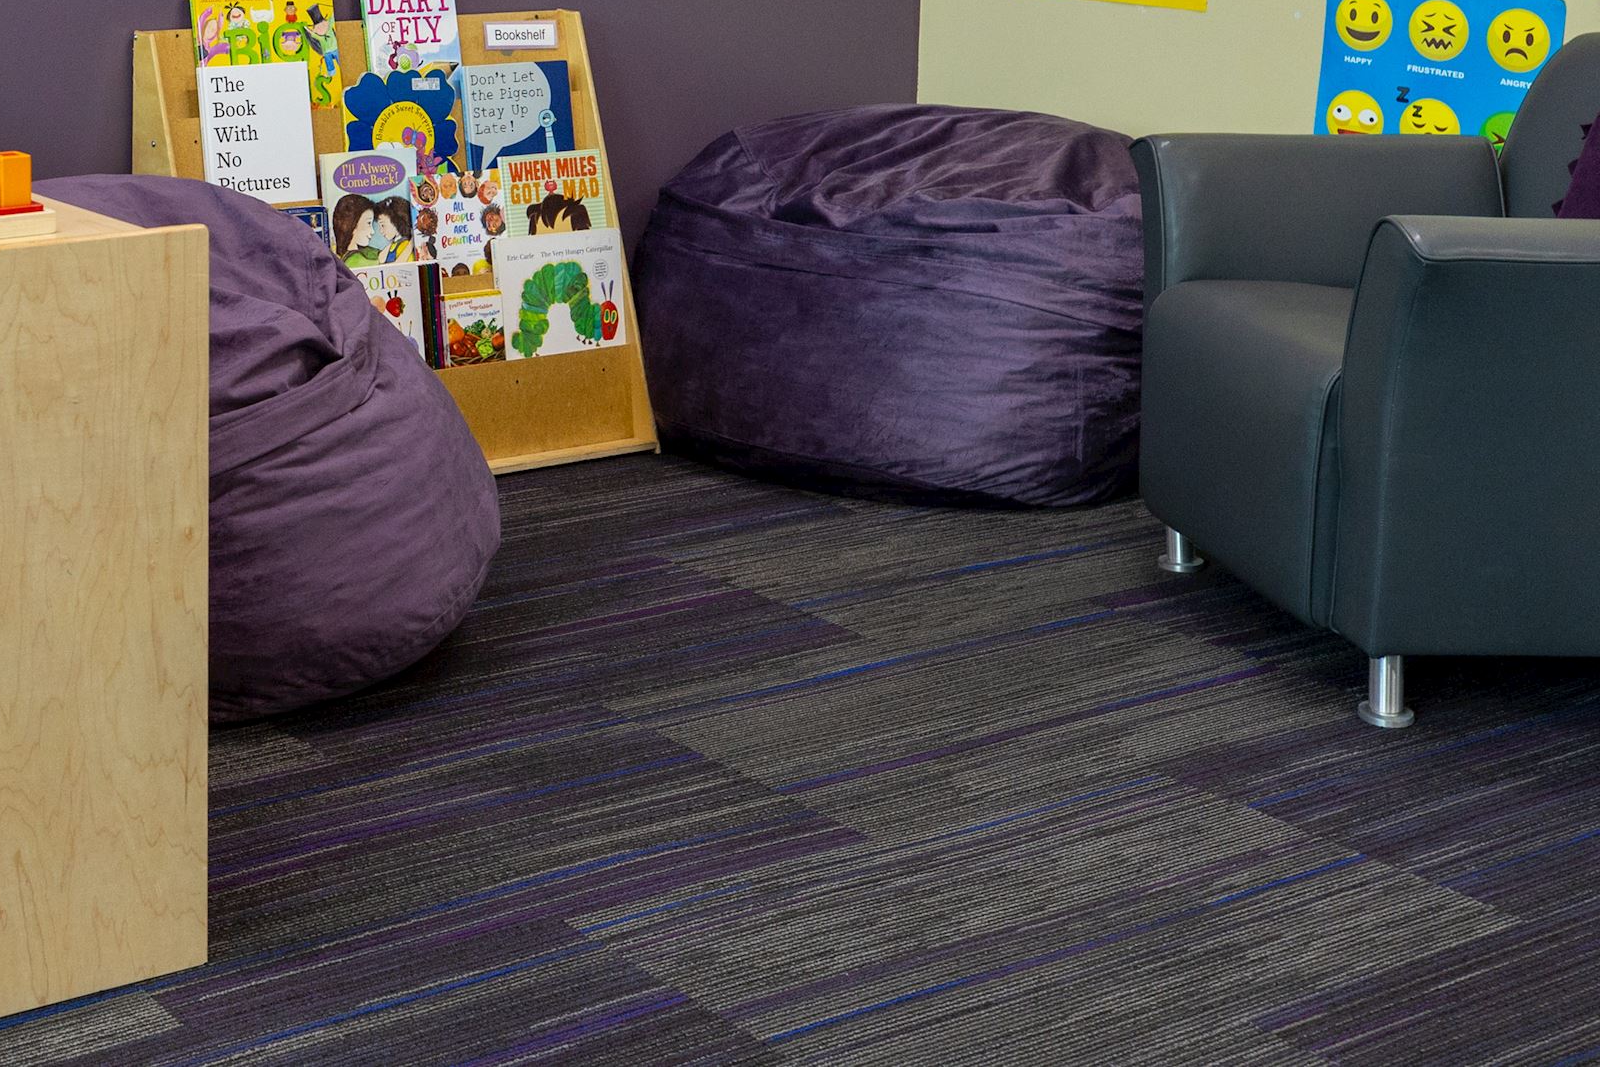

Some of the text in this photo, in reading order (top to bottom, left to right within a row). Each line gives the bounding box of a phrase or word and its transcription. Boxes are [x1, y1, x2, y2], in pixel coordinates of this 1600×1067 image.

[381, 21, 396, 34] OF
[396, 15, 442, 44] FLY
[495, 29, 546, 42] Bookshelf
[1344, 55, 1373, 66] HAPPY
[470, 70, 534, 86] Don't Let
[1406, 64, 1465, 79] FRUSTRATED
[211, 76, 245, 93] The
[1500, 78, 1531, 89] ANGRY
[471, 87, 544, 103] the Pigeon
[212, 100, 257, 118] Book
[473, 104, 528, 120] Stay Up
[415, 107, 434, 138] Surprise
[475, 120, 515, 135] Late!
[214, 125, 259, 143] With
[216, 152, 242, 168] No
[341, 162, 397, 176] I'll Always
[508, 155, 598, 183] WHEN MILES
[218, 176, 290, 193] Pictures
[339, 172, 399, 189] Come Back!
[510, 177, 599, 205] GOT MAD
[453, 201, 465, 212] ALL
[445, 212, 475, 225] PEOPLE
[453, 224, 469, 234] ARE
[441, 235, 483, 249] BEAUTIFUL
[507, 254, 519, 262] Eric
[565, 247, 585, 256] Hungry
[585, 245, 613, 253] Caterpillar
